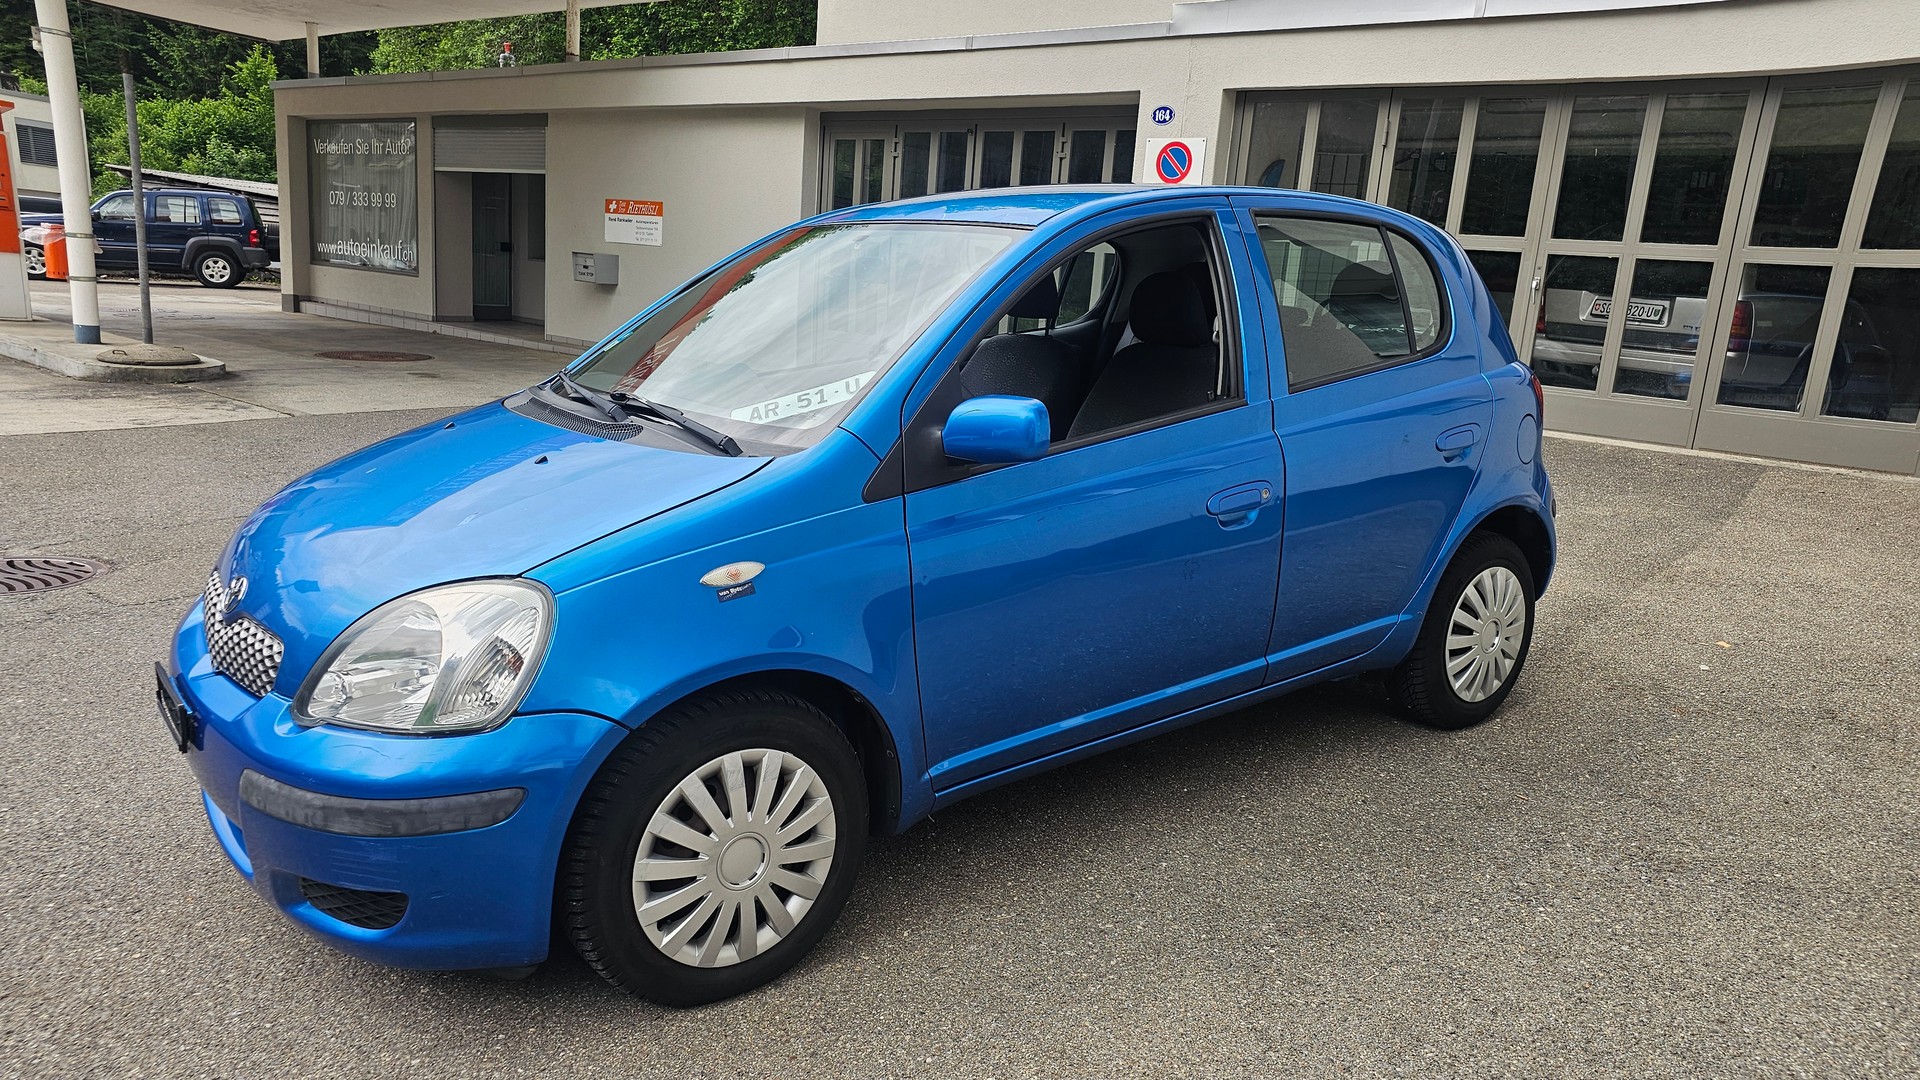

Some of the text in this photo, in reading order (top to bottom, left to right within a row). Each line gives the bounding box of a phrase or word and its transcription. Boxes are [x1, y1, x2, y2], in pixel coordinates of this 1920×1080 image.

[1155, 109, 1171, 122] 164
[313, 138, 411, 155] Verkaufen Sie Ihr Auto?
[329, 191, 345, 206] 079
[352, 191, 369, 207] 333
[371, 192, 382, 208] 99
[384, 192, 397, 208] 99
[317, 238, 413, 261] www.autoeinkauf.ch
